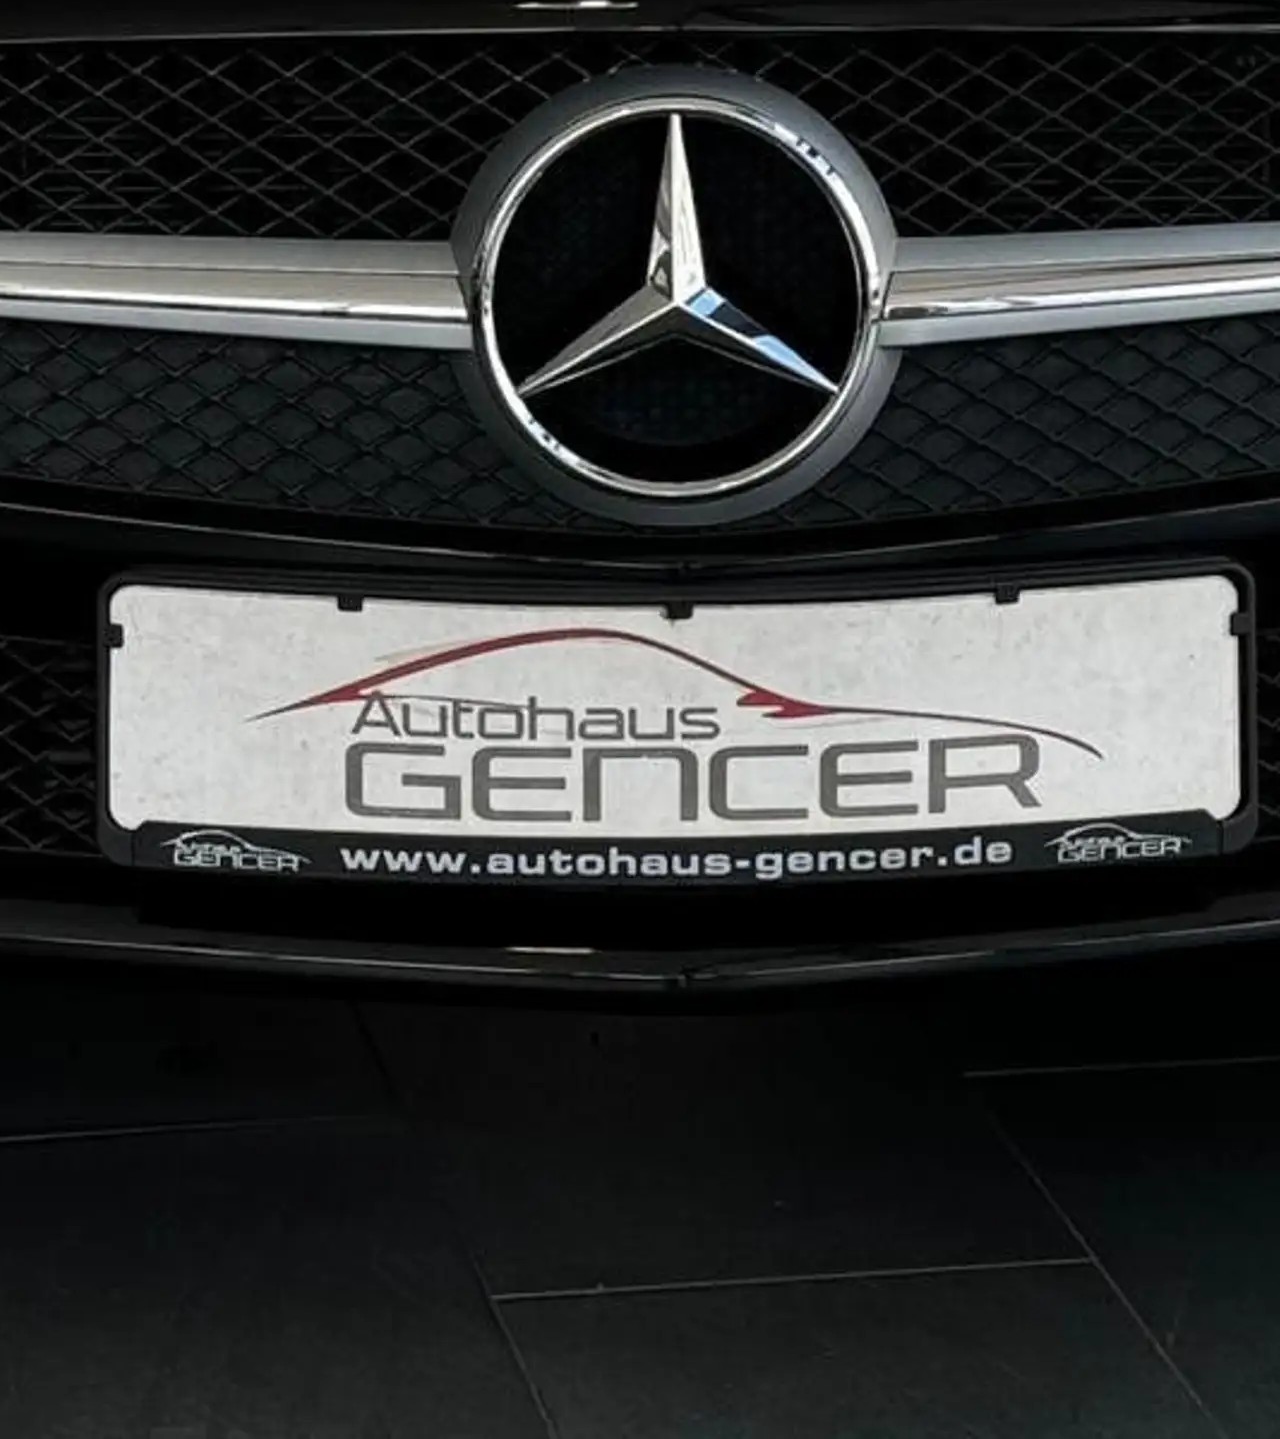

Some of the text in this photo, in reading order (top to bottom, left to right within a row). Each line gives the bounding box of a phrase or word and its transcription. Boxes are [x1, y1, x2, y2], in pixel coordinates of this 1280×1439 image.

[350, 691, 721, 741] Autohaus
[344, 733, 1042, 823] GENCER
[174, 848, 299, 873] GENCER
[339, 836, 1014, 879] www.autohaus-gencer.de
[1056, 836, 1182, 864] GENCER
